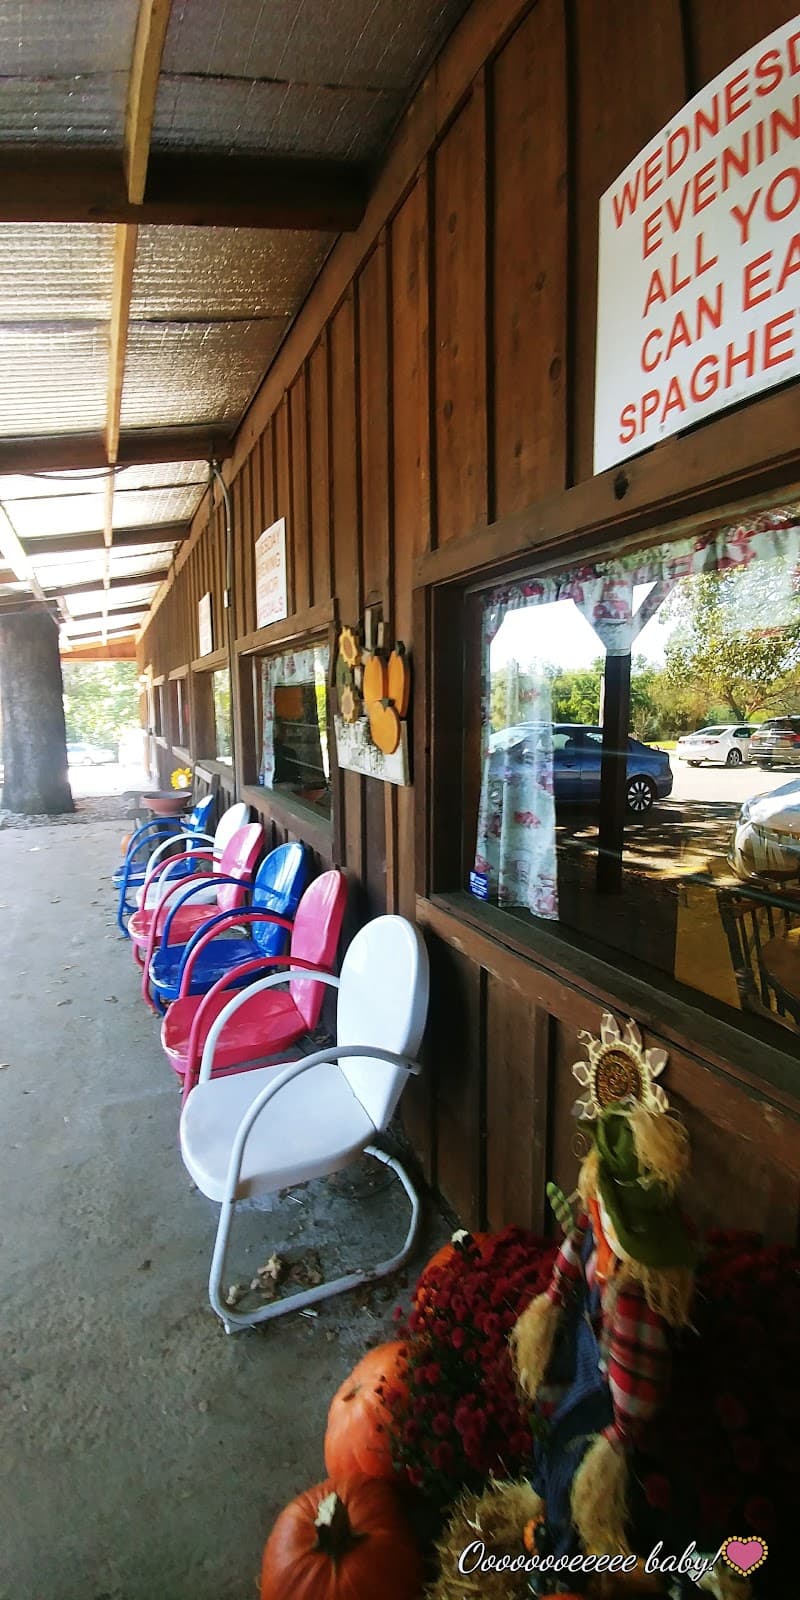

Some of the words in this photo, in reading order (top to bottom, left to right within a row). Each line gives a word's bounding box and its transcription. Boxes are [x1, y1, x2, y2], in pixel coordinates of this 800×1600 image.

[643, 94, 800, 260] EVENIN
[642, 233, 719, 319] ALL
[730, 167, 800, 245] YO
[619, 308, 800, 444] SPAGHE
[640, 283, 724, 374] CAN
[257, 527, 280, 558] ESDAY
[257, 552, 281, 580] ENING
